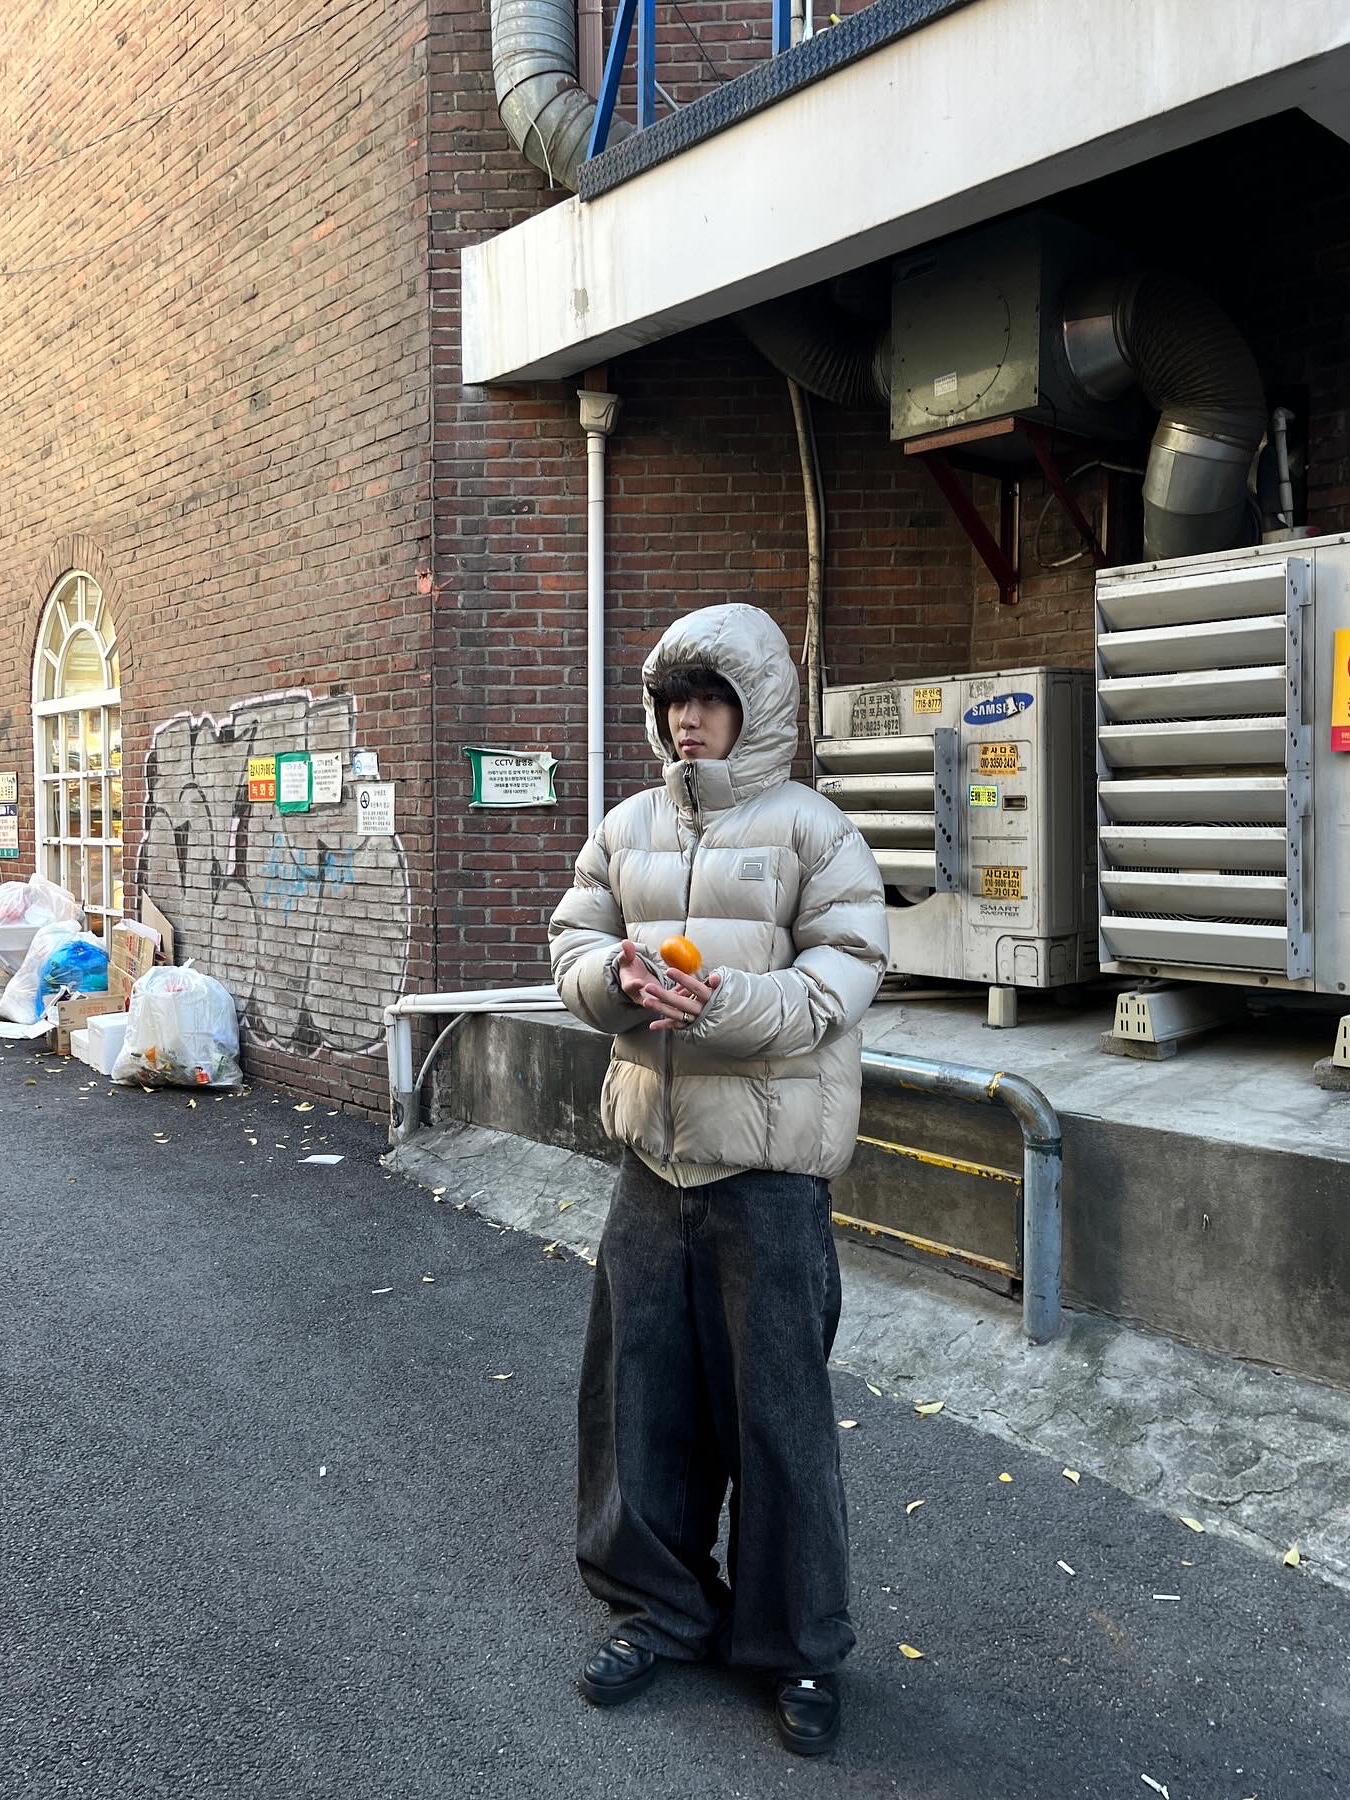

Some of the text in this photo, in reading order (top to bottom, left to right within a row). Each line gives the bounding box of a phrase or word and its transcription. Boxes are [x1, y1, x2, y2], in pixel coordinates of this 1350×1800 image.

[972, 702, 1025, 716] SAMSG
[494, 759, 513, 767] CCTV
[979, 904, 1020, 912] SMART
